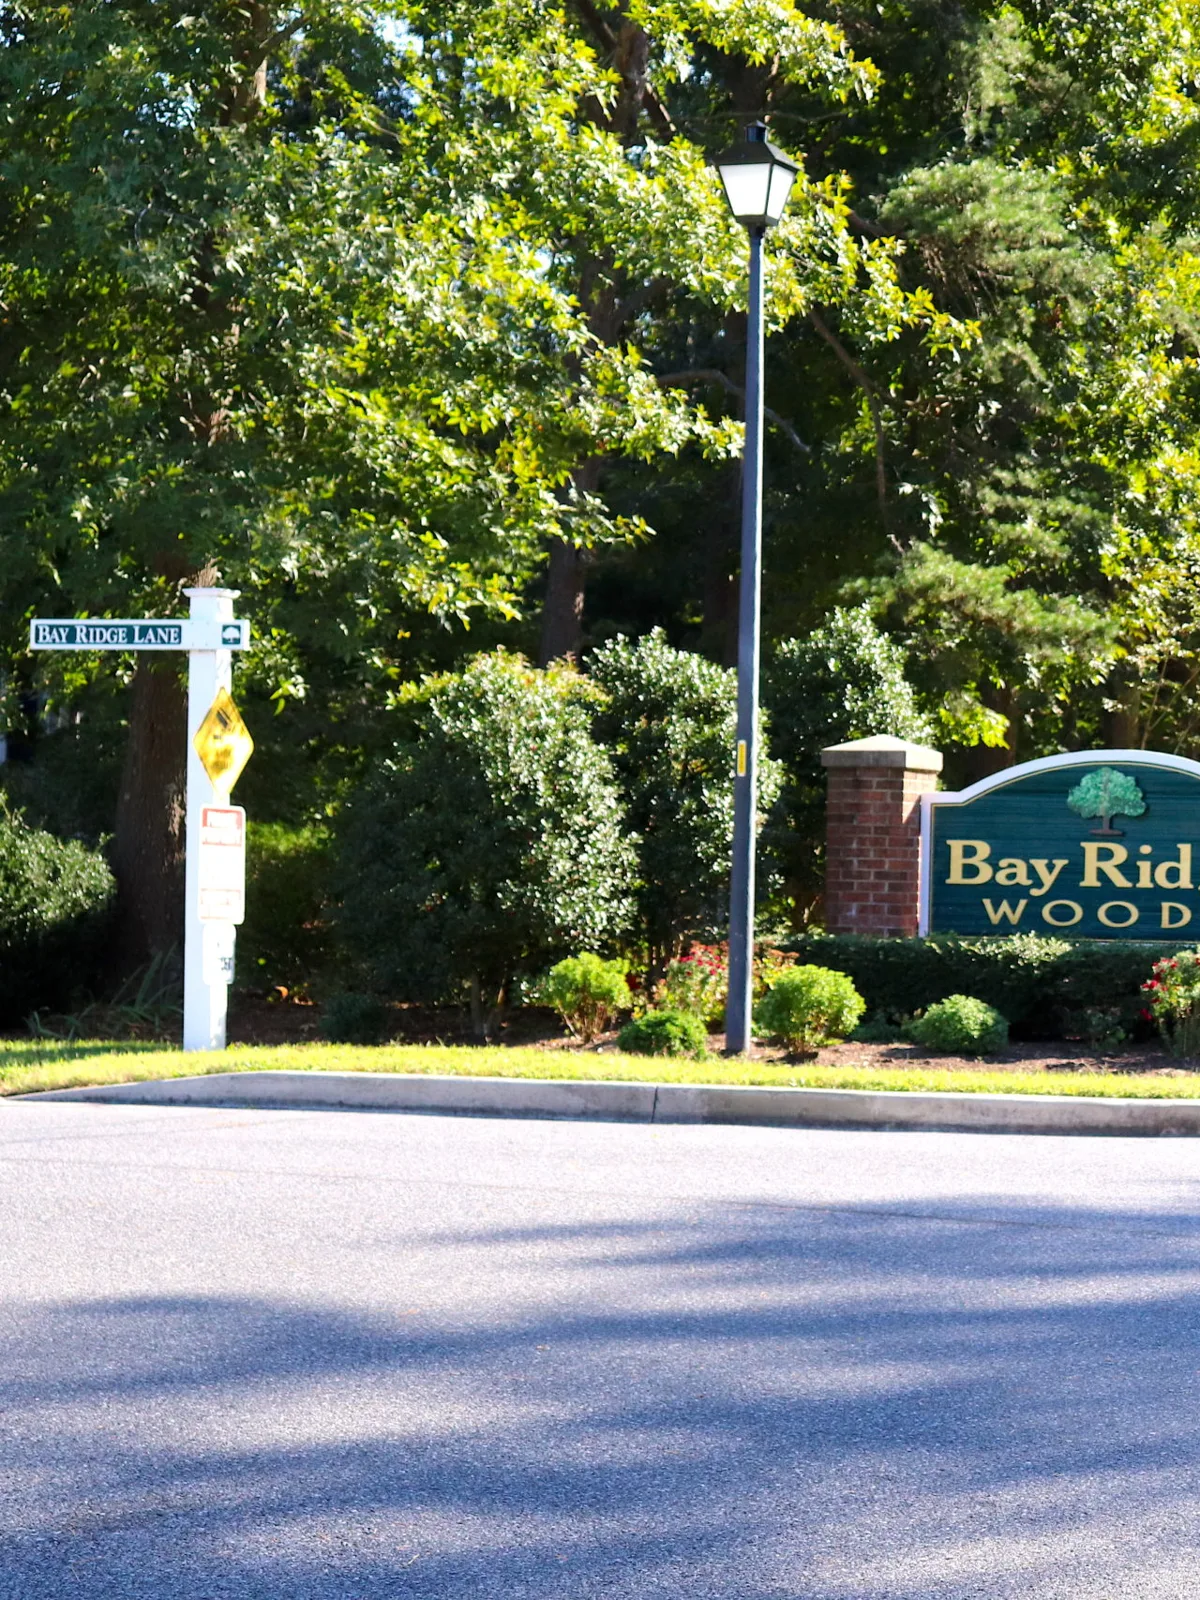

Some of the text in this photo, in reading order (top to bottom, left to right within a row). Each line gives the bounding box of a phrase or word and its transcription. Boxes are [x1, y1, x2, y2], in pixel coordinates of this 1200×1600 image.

[37, 625, 180, 644] BAY RIDGE LANE
[945, 839, 1069, 896] Bay
